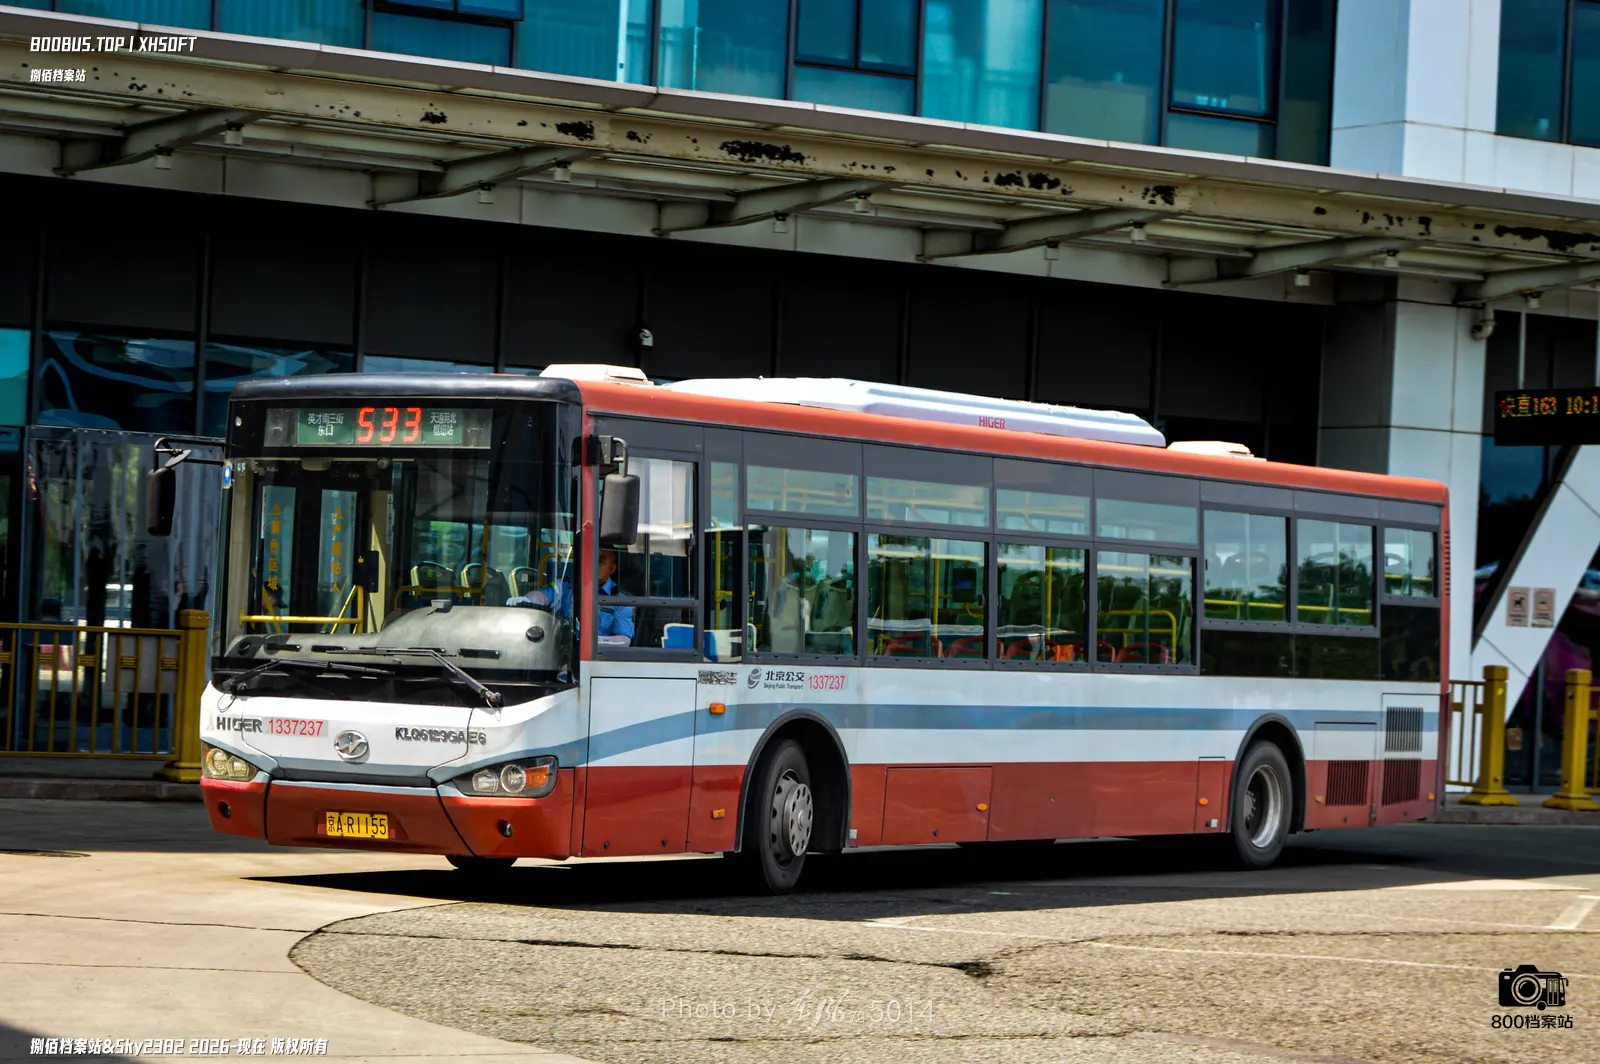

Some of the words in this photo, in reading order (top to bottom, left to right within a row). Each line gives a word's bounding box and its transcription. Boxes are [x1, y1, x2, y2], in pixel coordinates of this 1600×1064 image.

[317, 424, 334, 437] 东口
[356, 407, 423, 443] 533
[978, 416, 1006, 430] HIGER
[764, 670, 805, 682] 北京公交
[808, 675, 846, 690] 1337237
[216, 716, 263, 733] HIGER
[268, 718, 324, 736] 1337237
